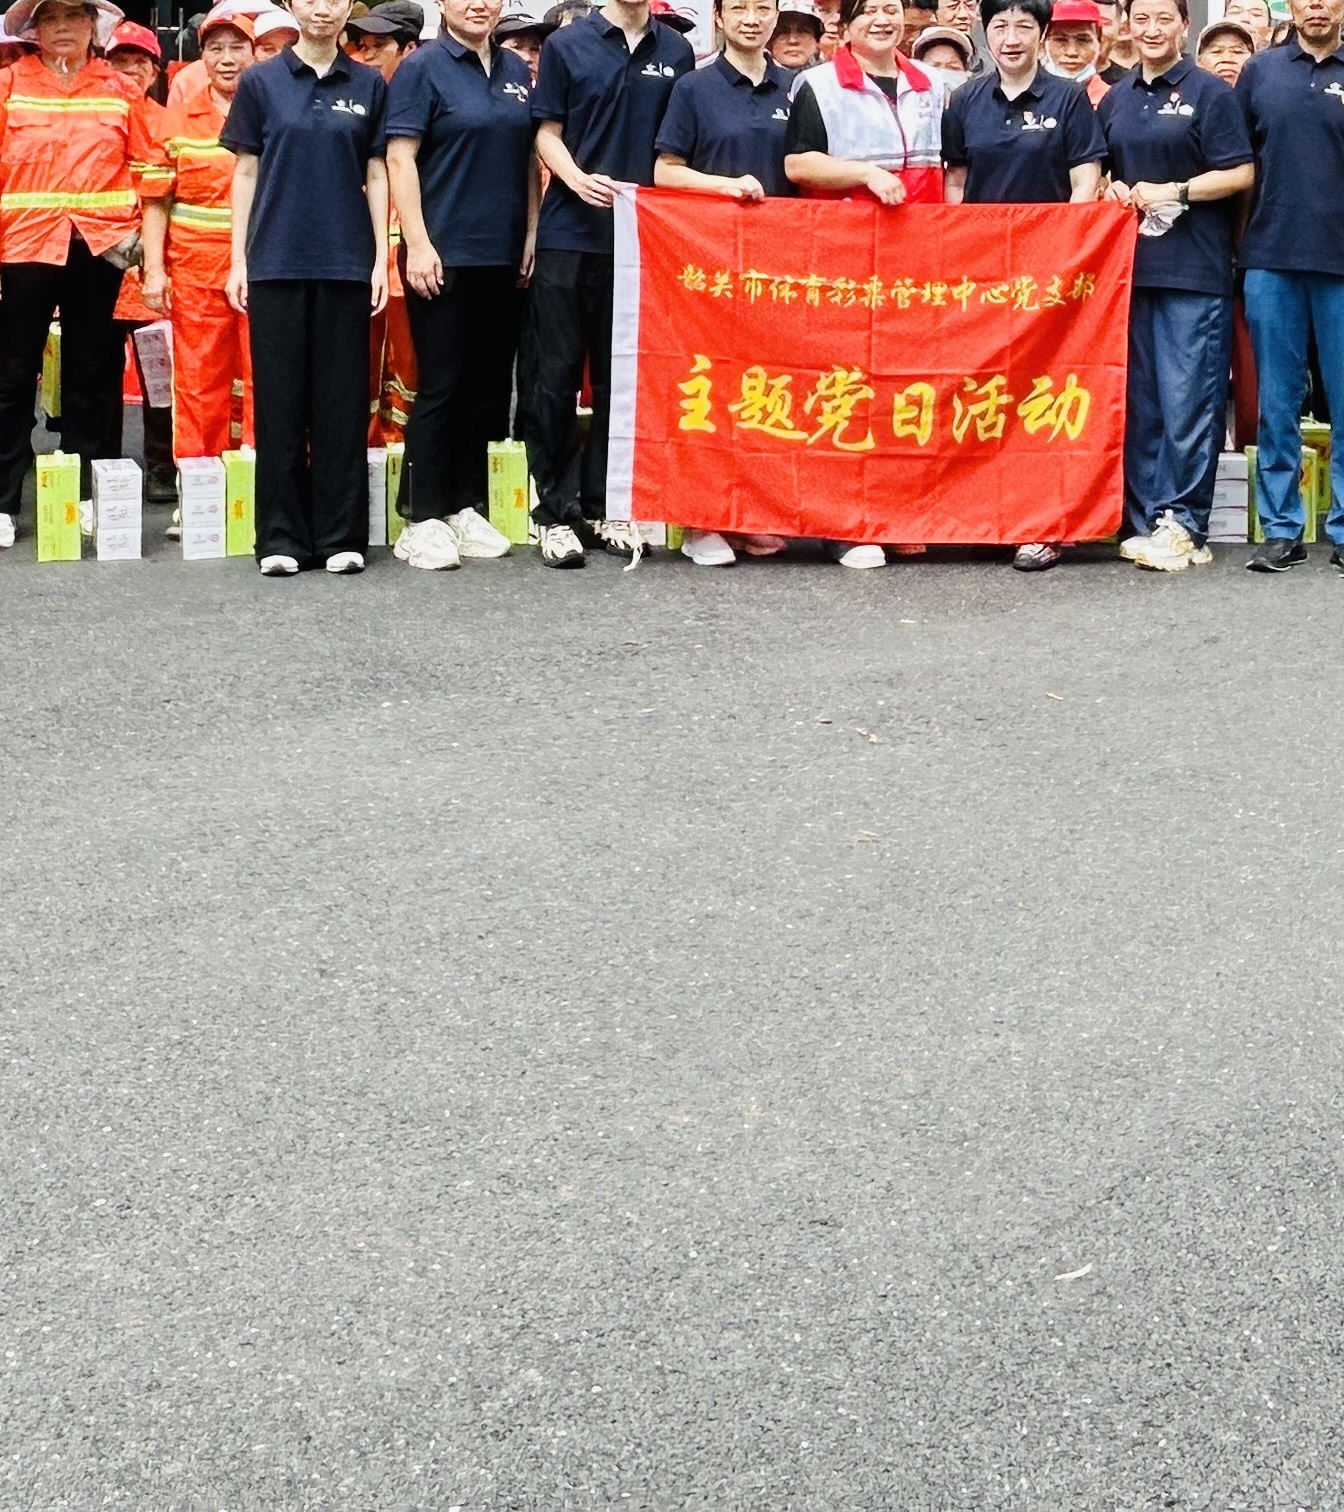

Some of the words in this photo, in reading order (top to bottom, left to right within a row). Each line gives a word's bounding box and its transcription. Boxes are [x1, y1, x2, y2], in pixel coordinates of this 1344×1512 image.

[677, 354, 1092, 451] 主题党日活动
